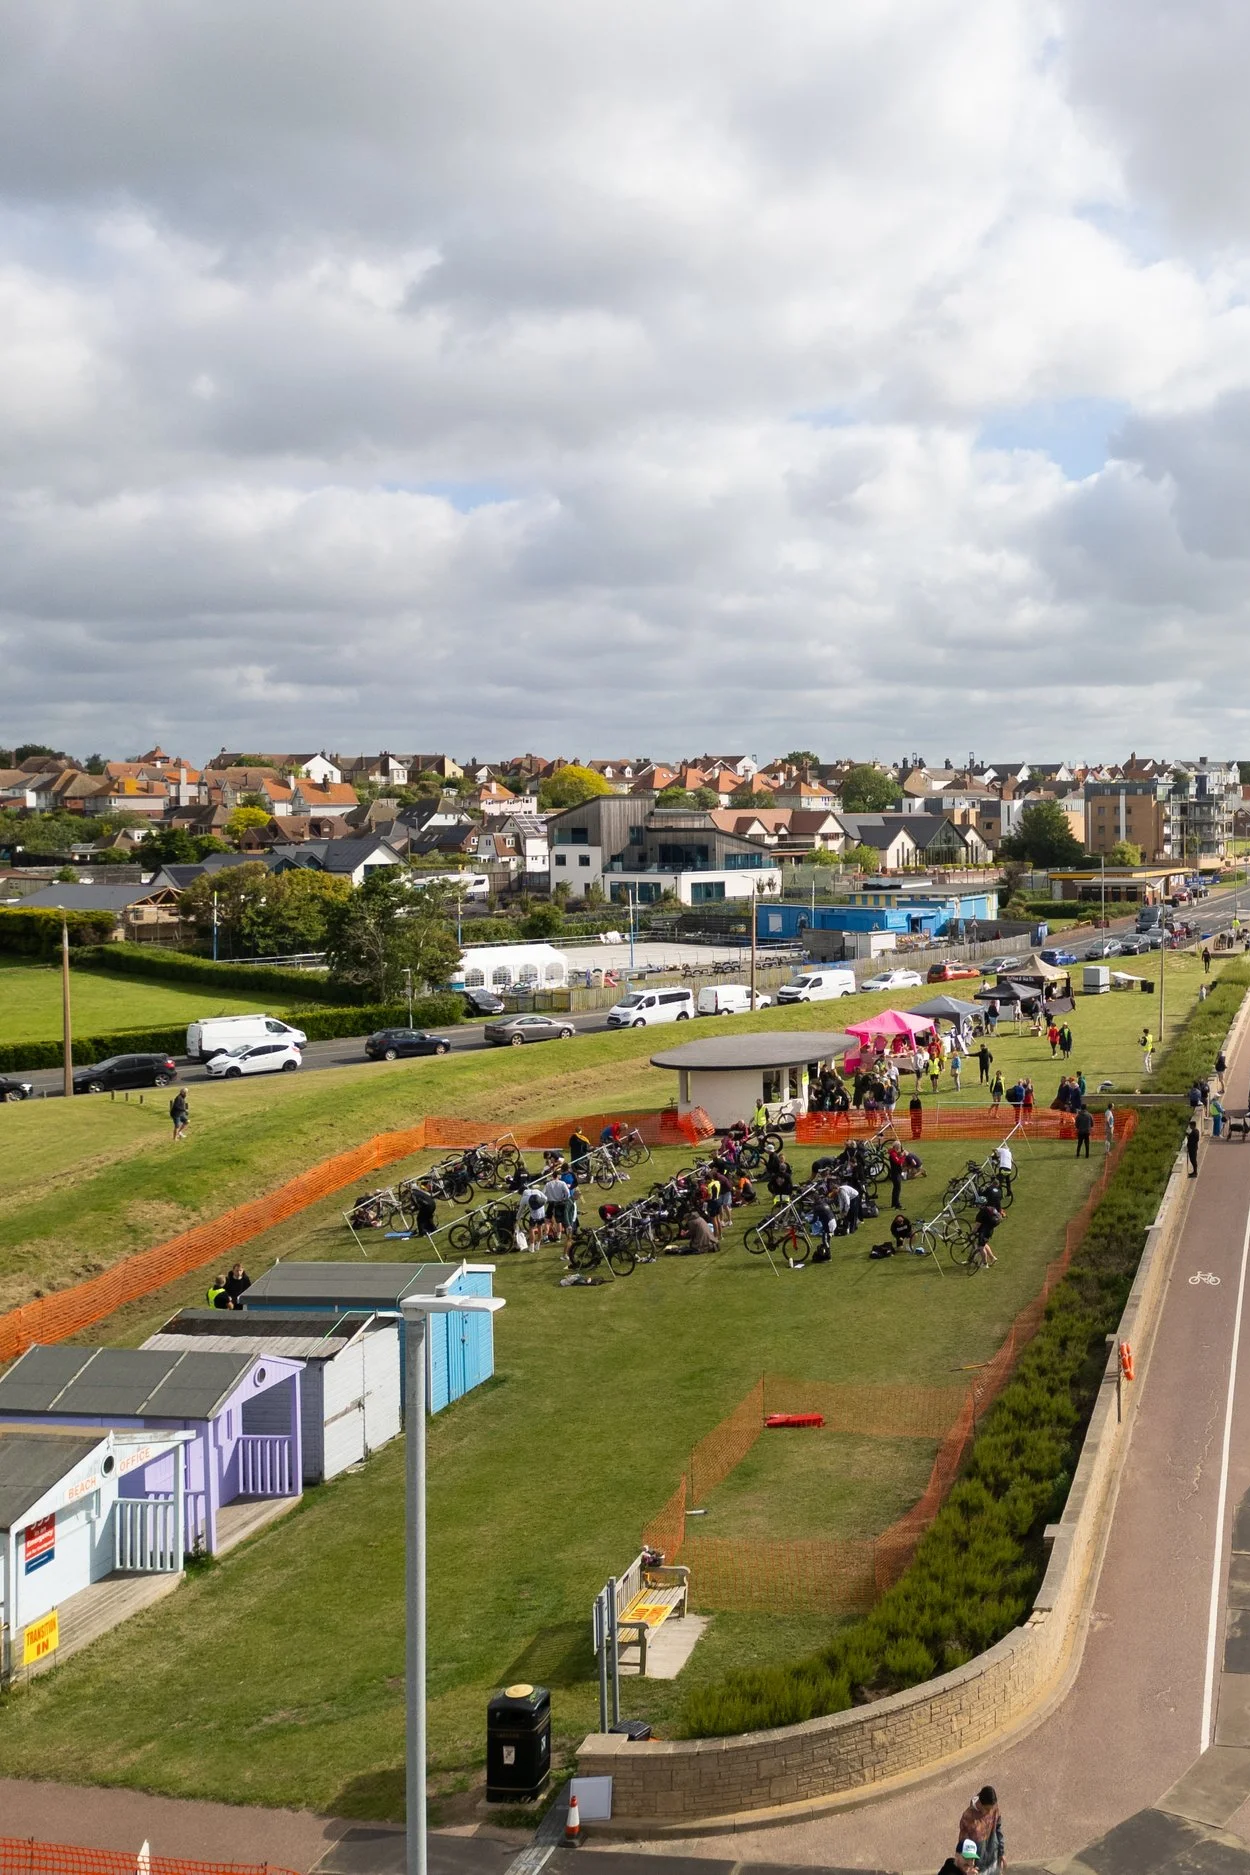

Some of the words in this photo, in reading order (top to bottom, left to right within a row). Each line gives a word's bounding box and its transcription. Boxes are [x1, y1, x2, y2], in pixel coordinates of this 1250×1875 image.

[68, 1476, 96, 1499] BEACH
[119, 1448, 150, 1471] OFFICE
[26, 1616, 56, 1647] TRANSITION
[36, 1638, 49, 1656] IN
